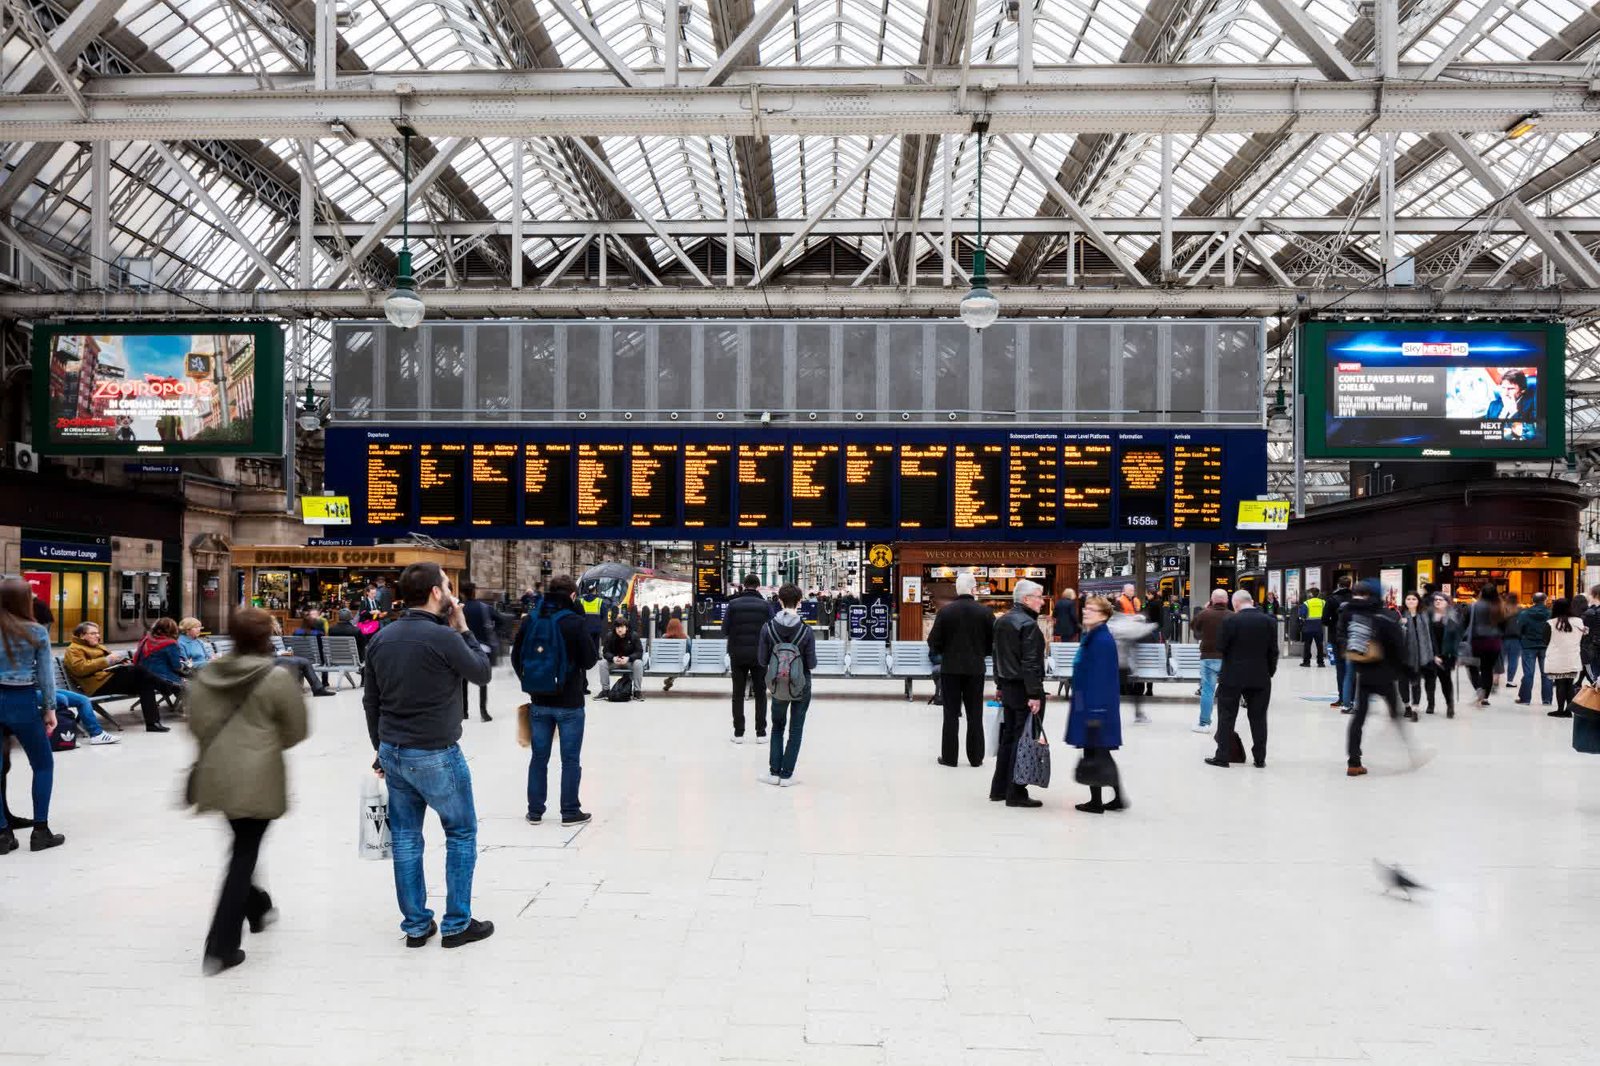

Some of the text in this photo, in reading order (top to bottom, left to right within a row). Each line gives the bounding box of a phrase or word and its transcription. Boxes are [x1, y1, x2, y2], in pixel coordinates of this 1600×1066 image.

[1404, 344, 1467, 355] sky NEWS HD
[1367, 375, 1394, 383] PAVES
[1396, 375, 1415, 383] WAY
[1417, 375, 1434, 383] FOR
[1339, 383, 1376, 391] CHELSEA
[155, 400, 182, 409] MARCH
[1481, 422, 1502, 430] NEXT
[51, 547, 97, 560] Customer Lounge
[255, 552, 396, 564] STARBUCKS COFFEE
[926, 551, 950, 559] WEST
[953, 551, 1005, 559] CORNWALL
[1008, 551, 1037, 559] PASTY
[1169, 557, 1176, 566] 6
